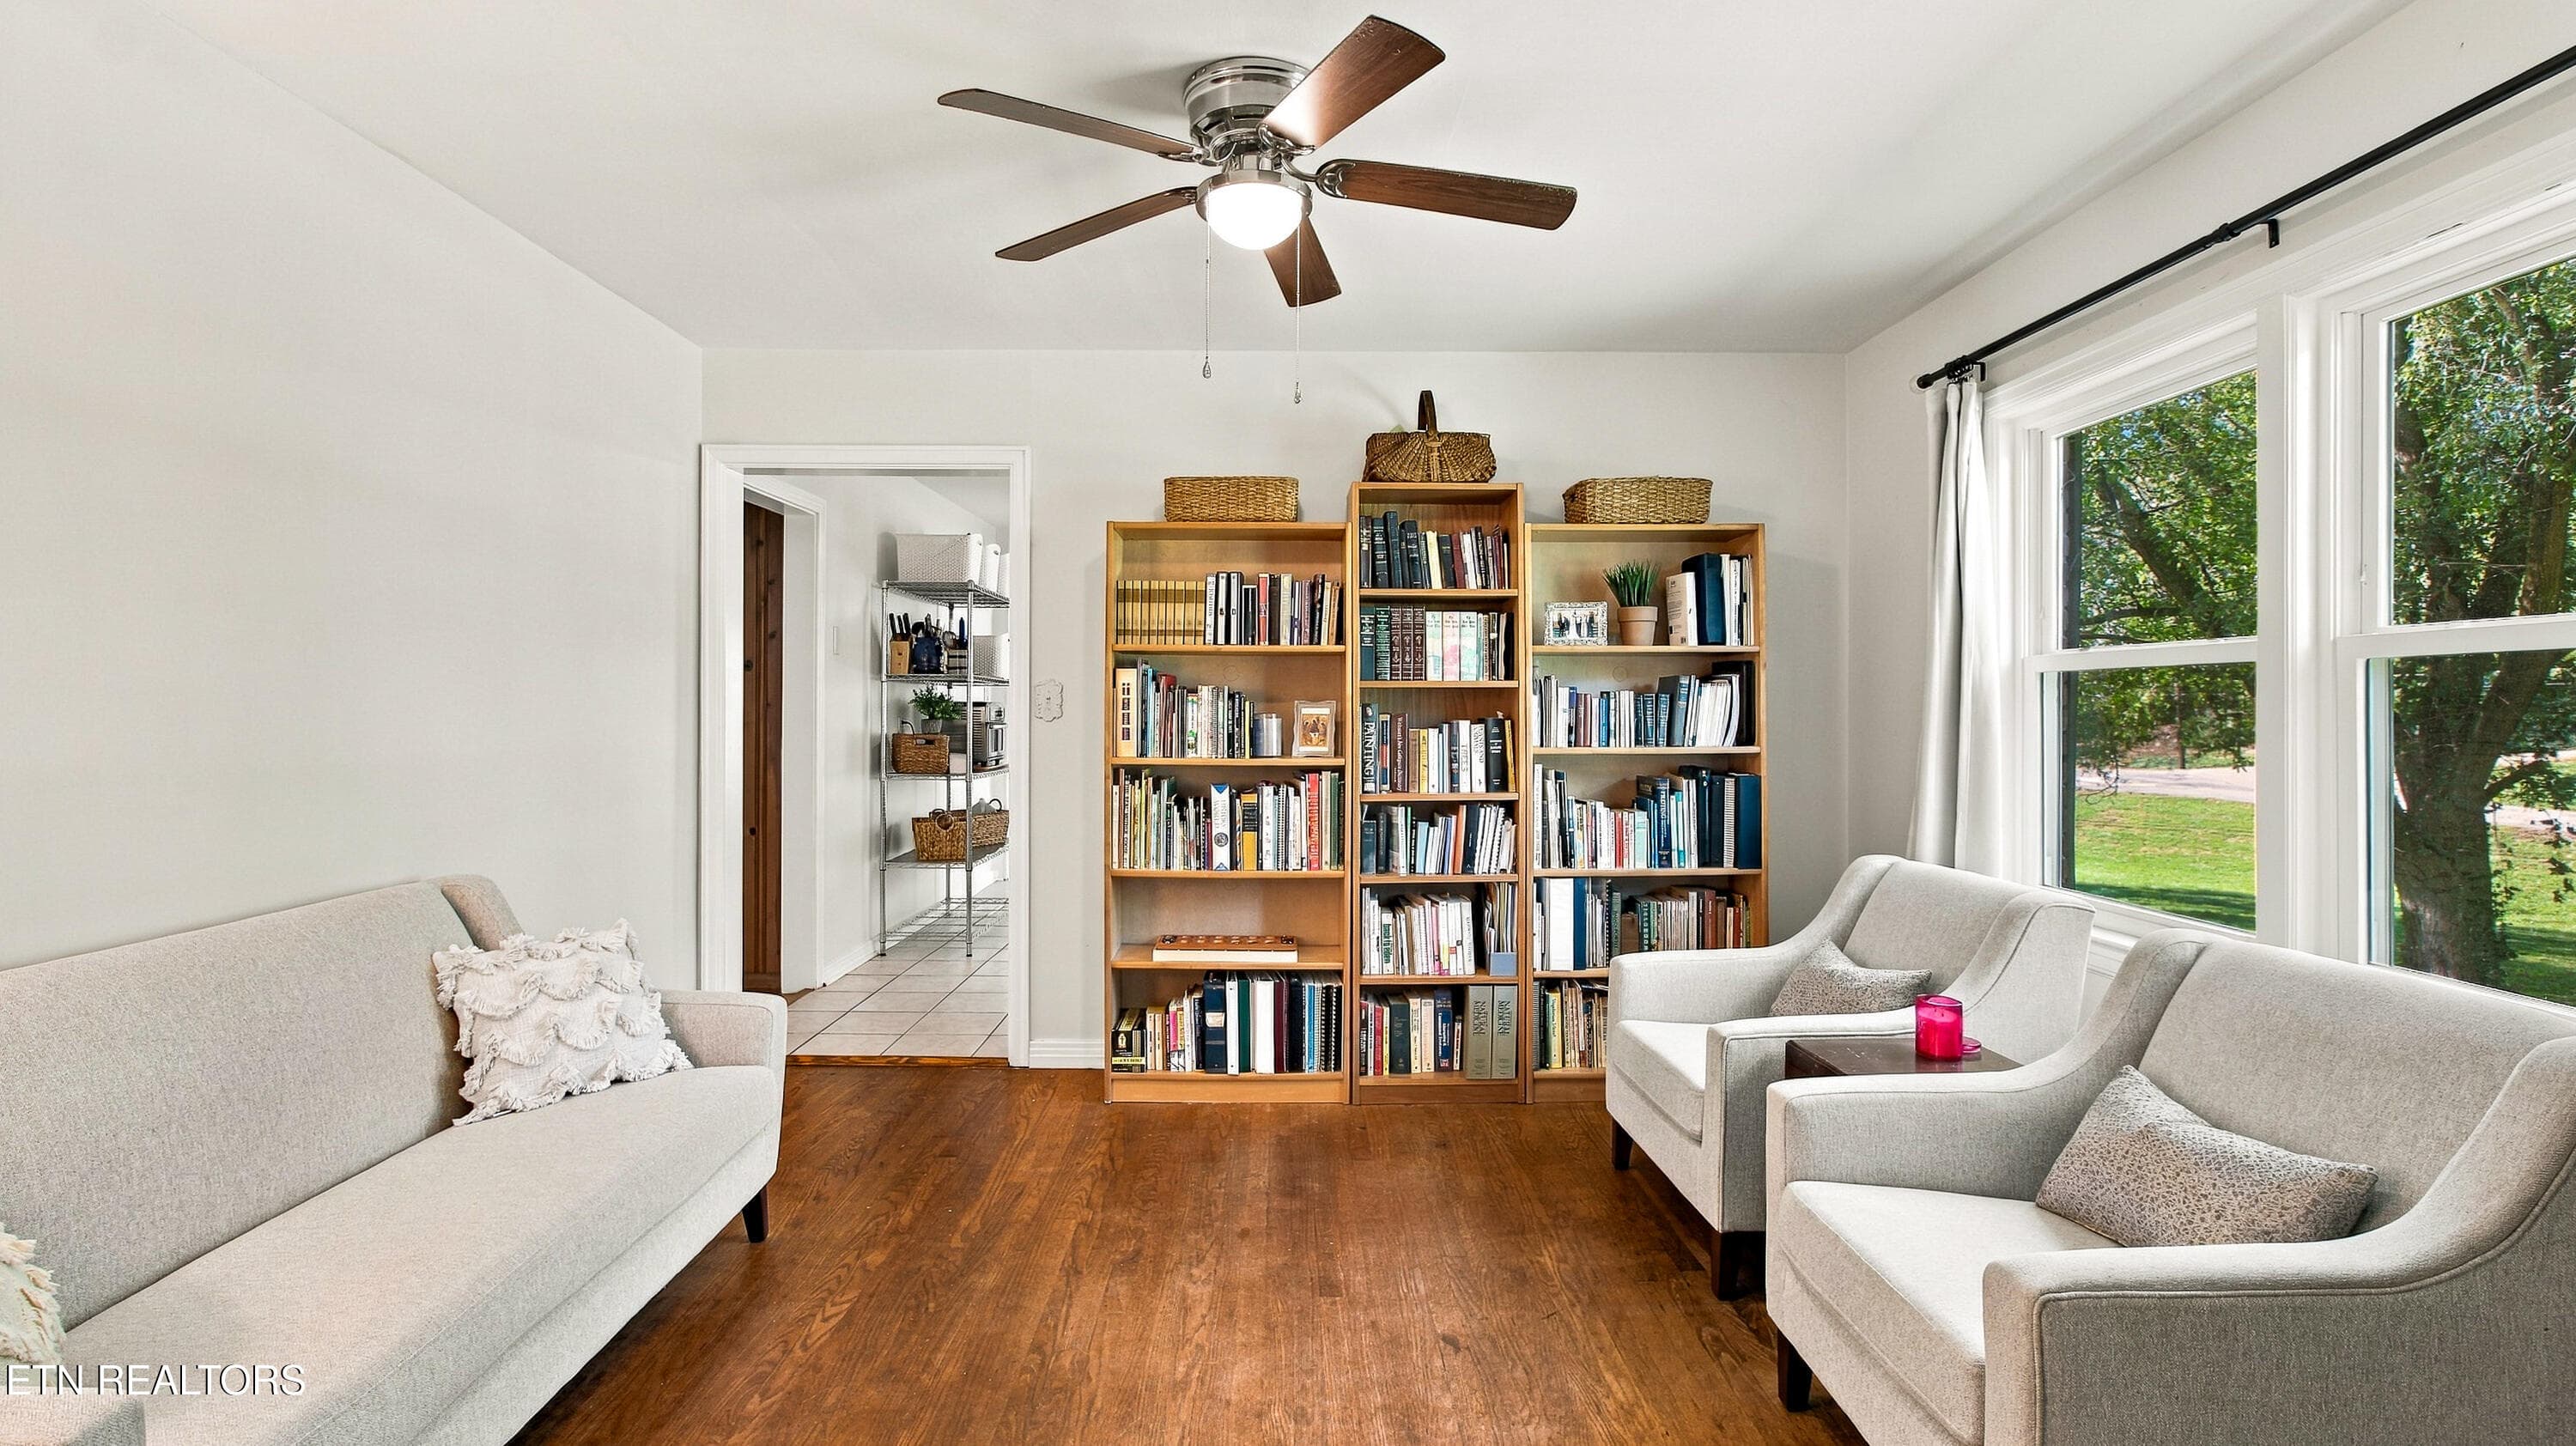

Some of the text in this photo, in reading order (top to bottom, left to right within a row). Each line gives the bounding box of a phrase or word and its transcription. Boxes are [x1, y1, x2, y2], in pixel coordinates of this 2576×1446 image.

[1364, 721, 1376, 775] PAINTING
[1382, 923, 1392, 939] back
[1383, 947, 1392, 963] eden
